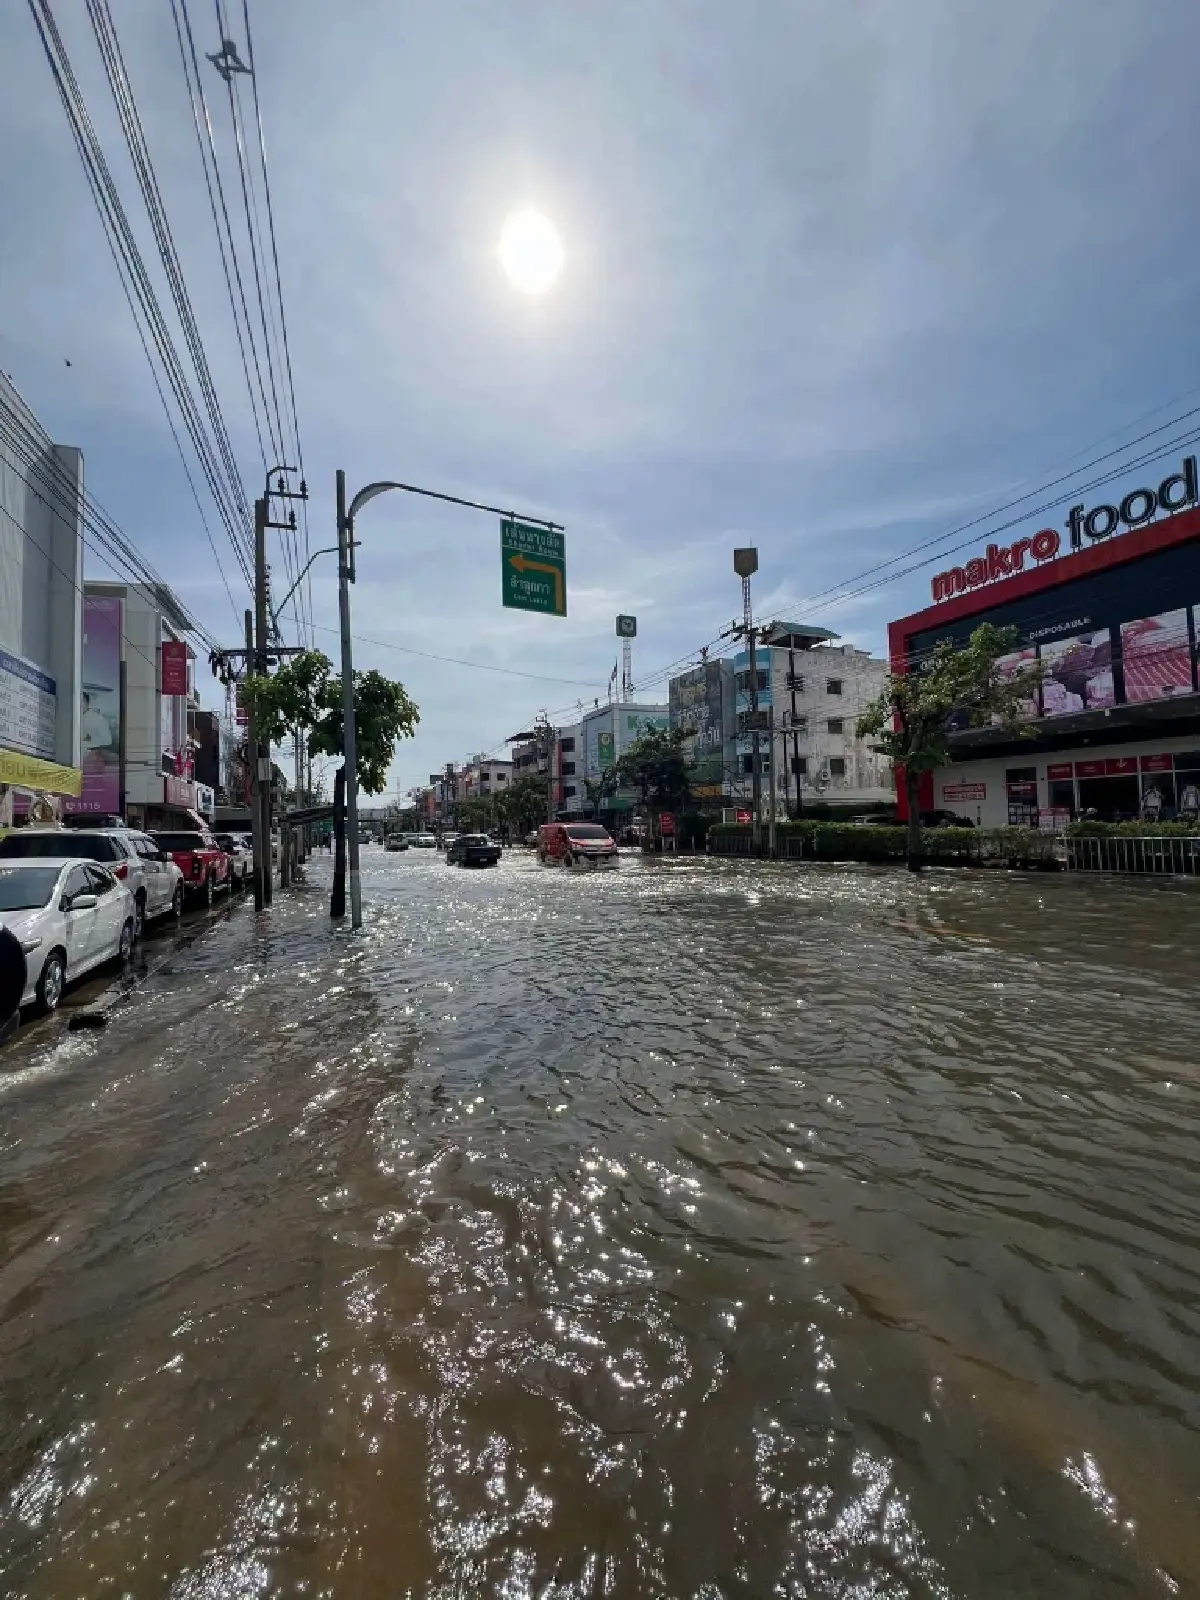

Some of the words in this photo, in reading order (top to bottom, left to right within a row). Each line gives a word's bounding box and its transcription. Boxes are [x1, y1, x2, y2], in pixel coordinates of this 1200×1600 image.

[932, 528, 1060, 601] makro
[1066, 455, 1199, 548] food
[1030, 615, 1091, 640] DISPOSABLE
